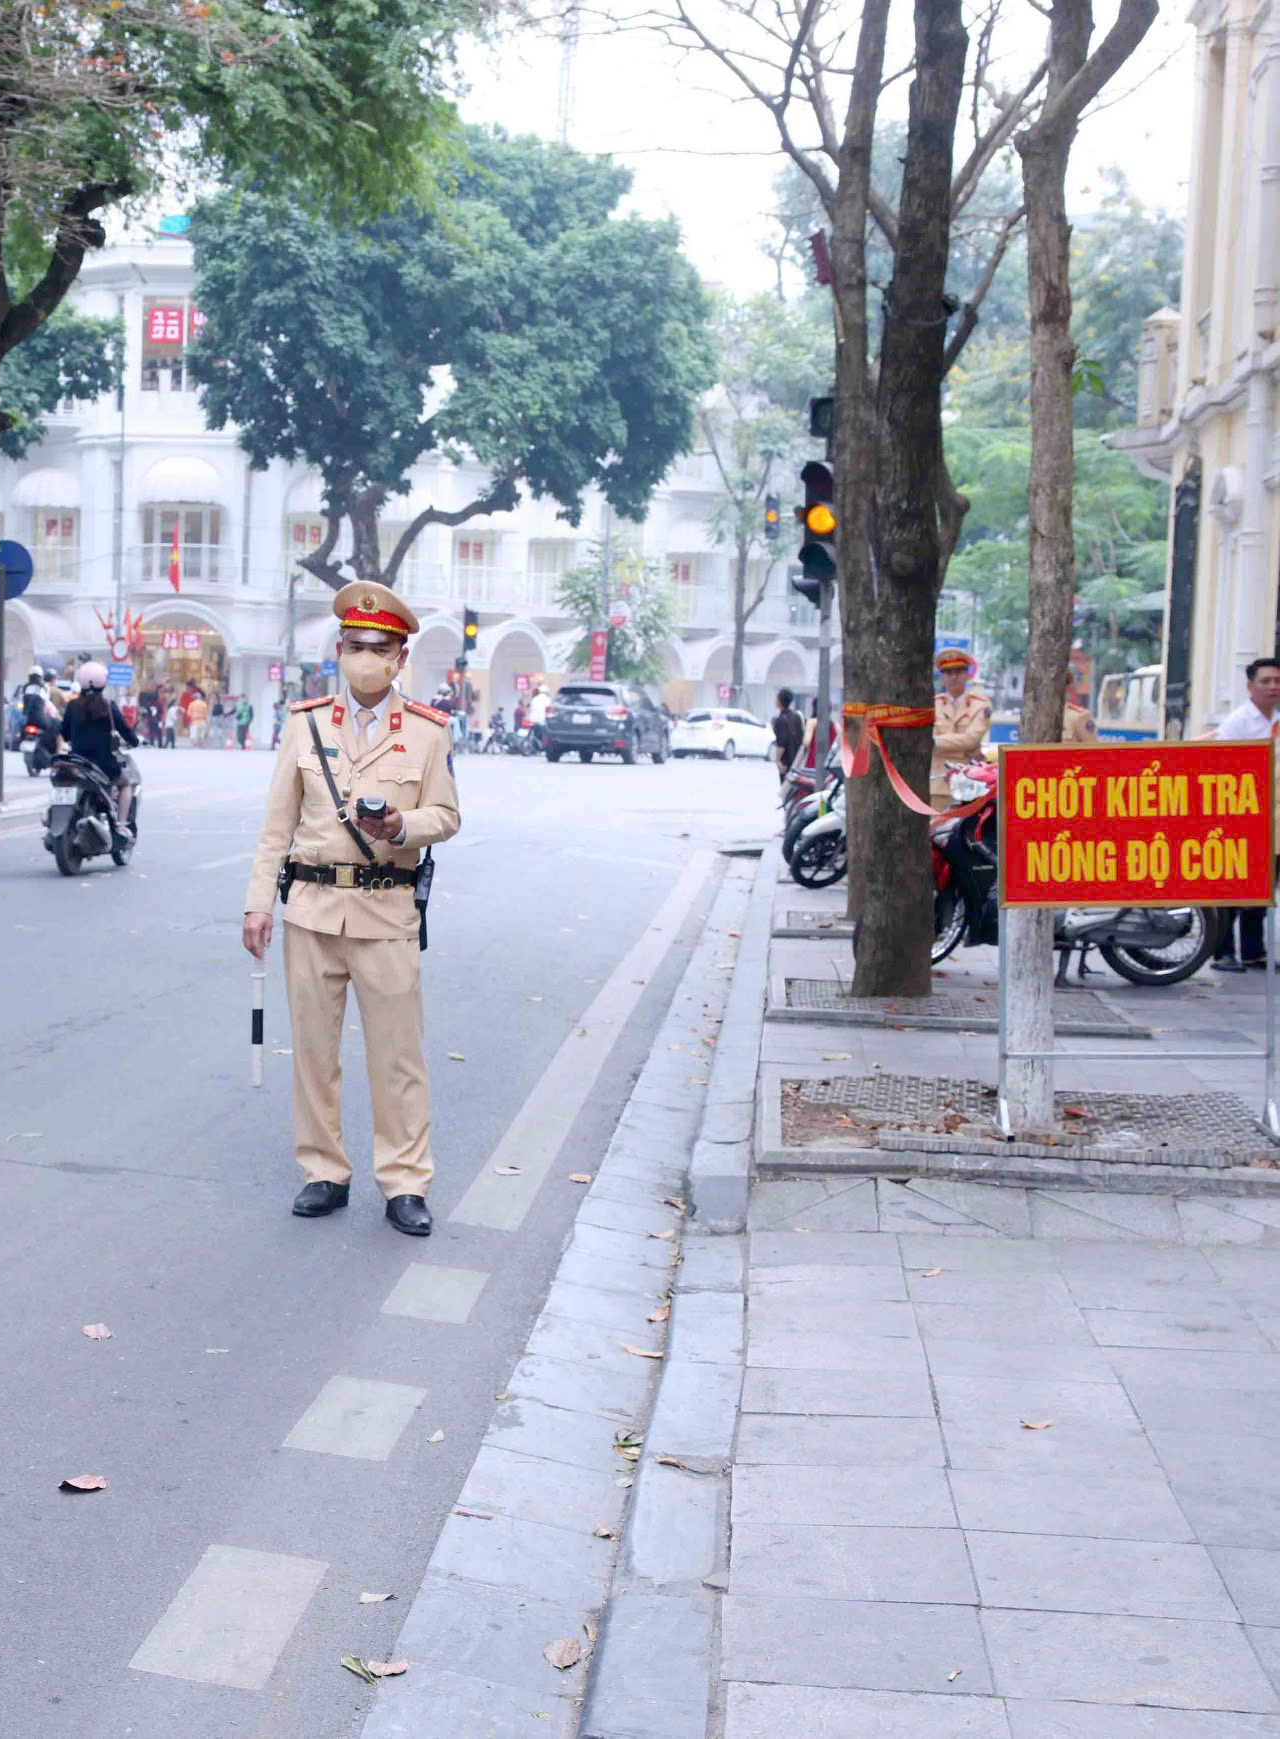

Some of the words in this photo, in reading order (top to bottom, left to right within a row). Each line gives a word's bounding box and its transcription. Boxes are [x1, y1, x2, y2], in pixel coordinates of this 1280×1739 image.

[1016, 766, 1097, 819] CHỐT
[1106, 760, 1188, 817] KIỂM
[1198, 773, 1260, 815] TRA
[1027, 830, 1117, 882] NỒNG
[1126, 832, 1170, 888] ĐỘ
[1180, 827, 1248, 881] CỒN
